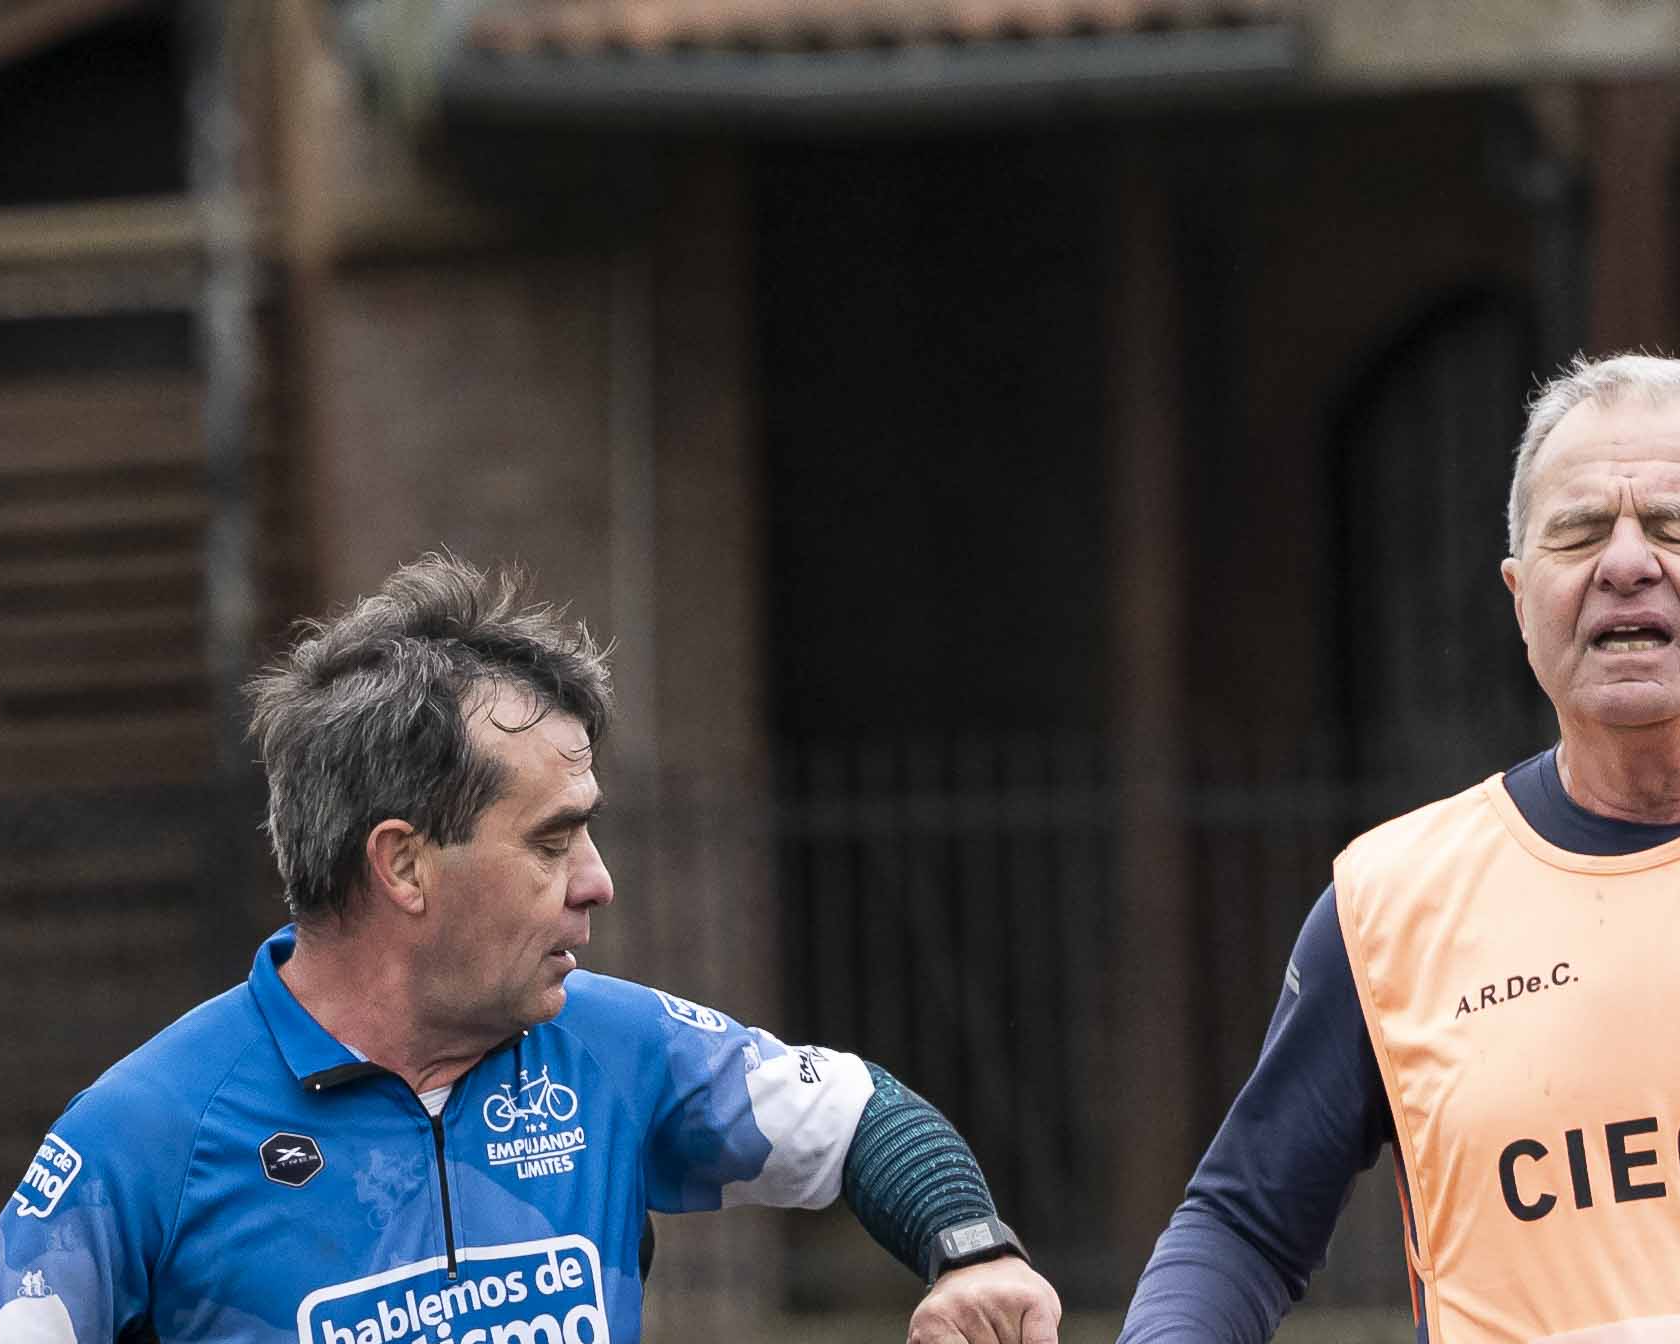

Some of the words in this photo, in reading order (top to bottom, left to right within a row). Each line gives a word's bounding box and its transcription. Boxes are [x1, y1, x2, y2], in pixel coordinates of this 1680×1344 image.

[486, 1126, 586, 1161] EMPUJANDO
[516, 1155, 575, 1180] LIMITES
[534, 1249, 585, 1296] de
